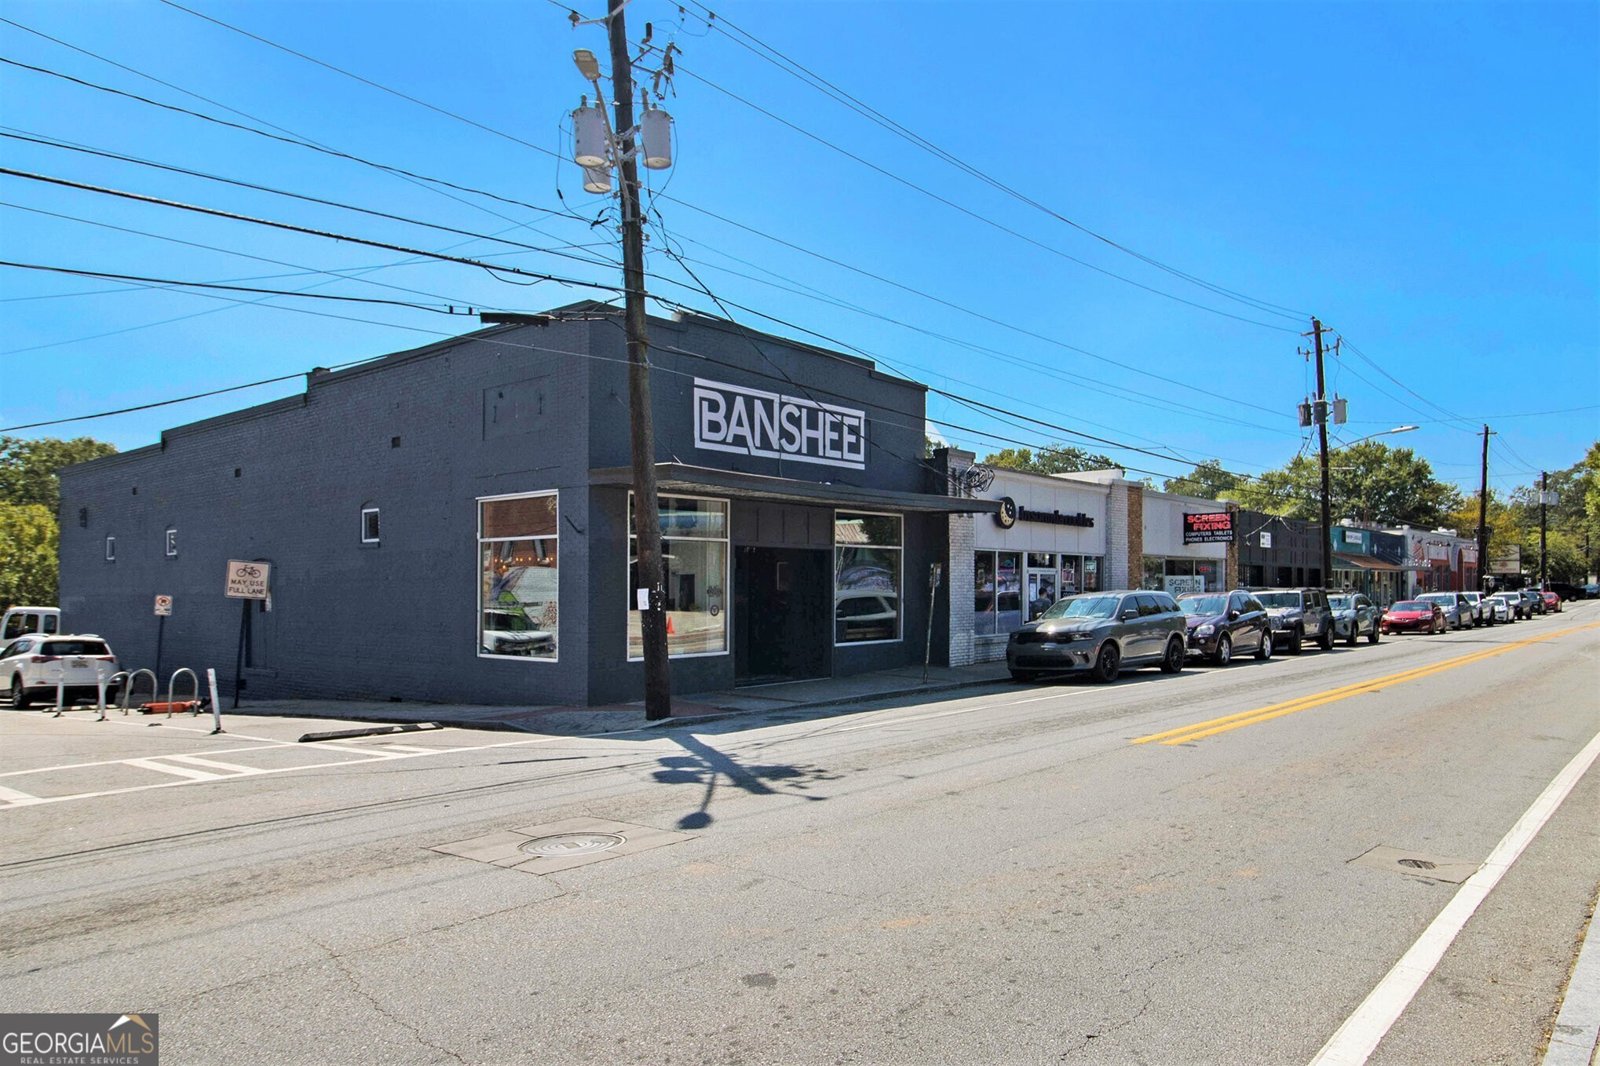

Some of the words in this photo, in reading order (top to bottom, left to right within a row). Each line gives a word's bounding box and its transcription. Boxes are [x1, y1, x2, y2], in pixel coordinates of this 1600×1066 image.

[694, 386, 865, 464] BANSHEE
[1187, 513, 1231, 523] SCREEN
[1193, 521, 1231, 531] FIXING
[228, 586, 245, 594] FULL
